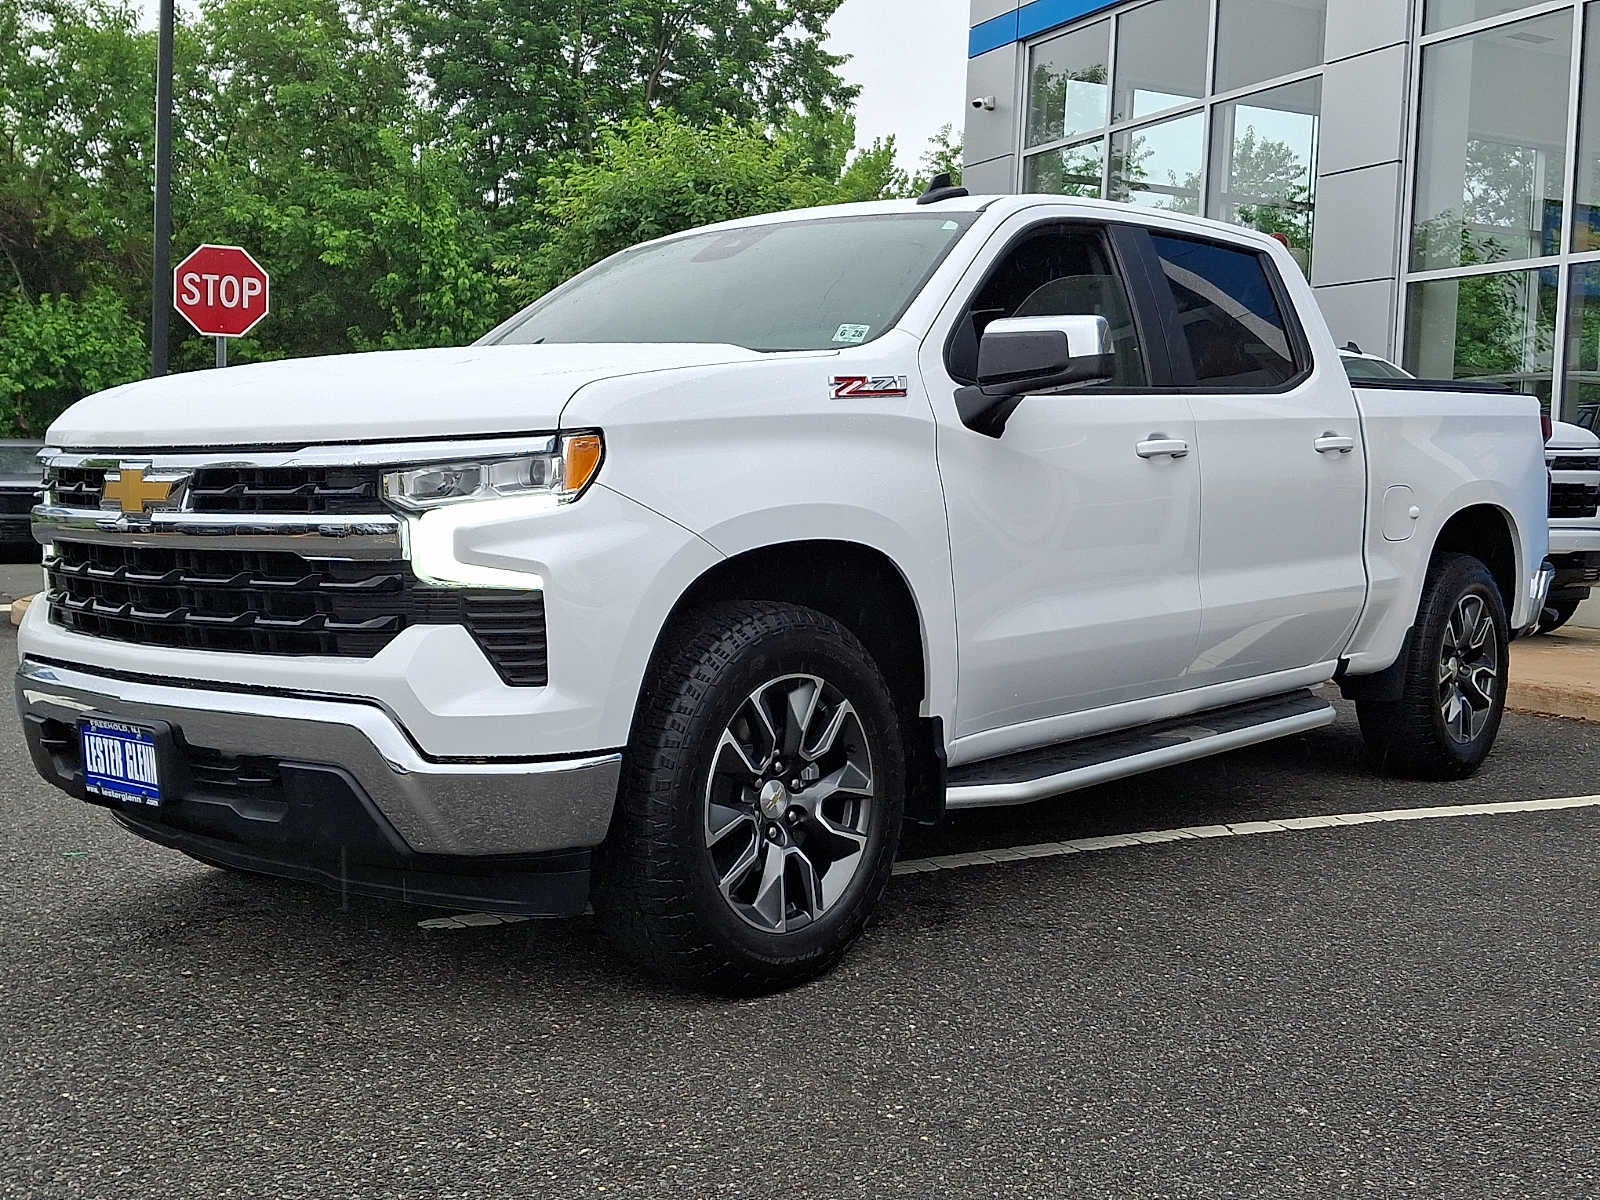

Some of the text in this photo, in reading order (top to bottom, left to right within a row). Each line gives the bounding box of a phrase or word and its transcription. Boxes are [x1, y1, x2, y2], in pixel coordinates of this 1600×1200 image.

[181, 272, 262, 309] STOP
[828, 375, 908, 399] Z71
[84, 735, 158, 785] LESTER GLENN
[101, 787, 142, 803] lesterglenn
